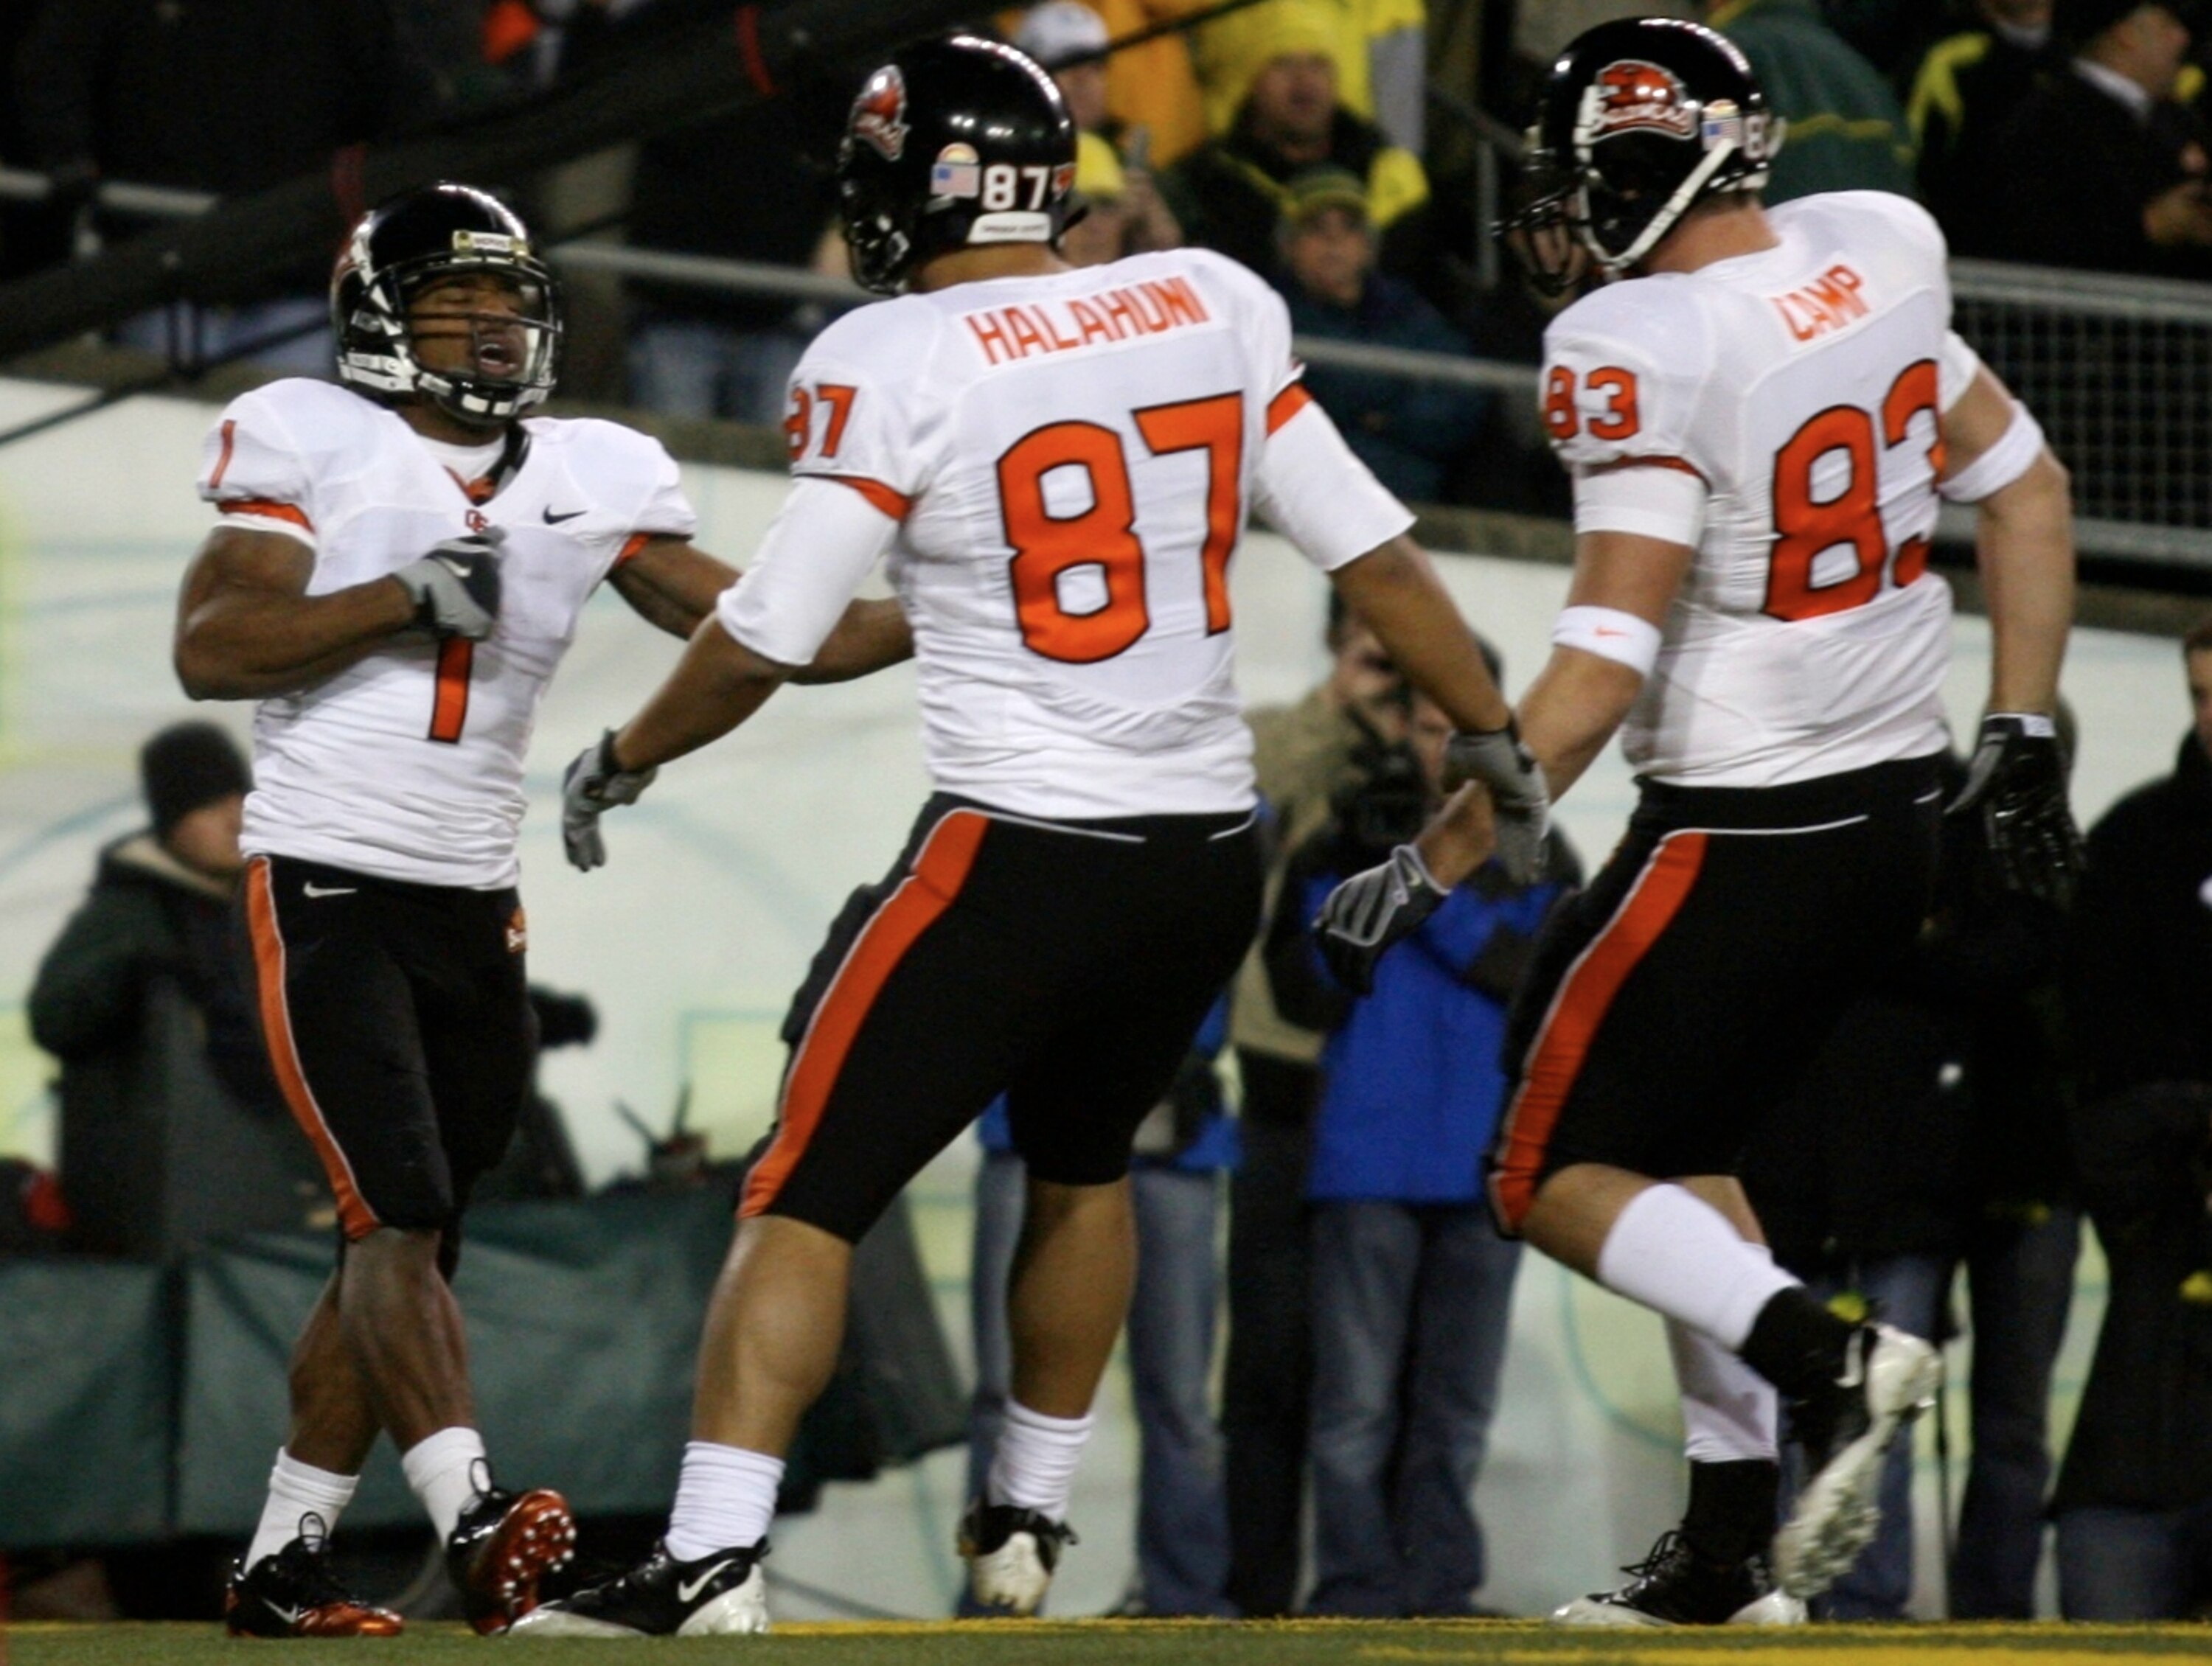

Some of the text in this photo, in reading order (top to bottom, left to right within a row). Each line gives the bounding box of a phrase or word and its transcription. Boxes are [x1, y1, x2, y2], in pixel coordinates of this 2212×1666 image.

[981, 164, 1049, 211] 87
[964, 276, 1211, 366] HALAHUNI
[1771, 264, 1871, 342] LAMP
[1544, 365, 1641, 441] 83
[996, 389, 1245, 663] 87
